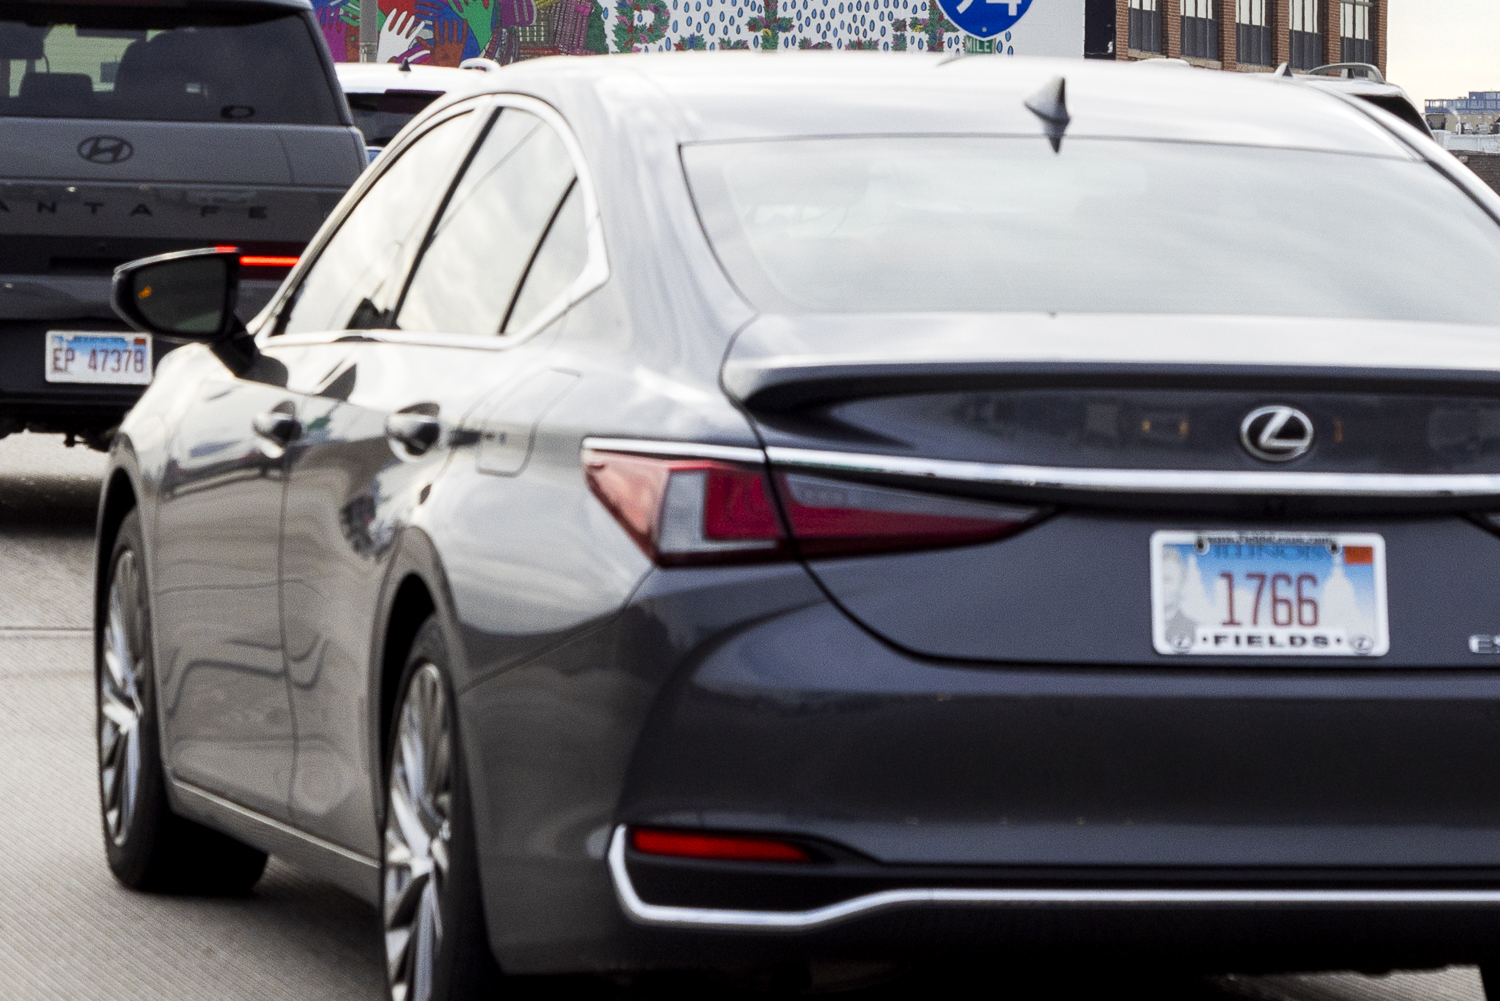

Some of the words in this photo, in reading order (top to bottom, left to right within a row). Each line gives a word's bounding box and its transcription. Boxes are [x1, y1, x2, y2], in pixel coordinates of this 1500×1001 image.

[53, 347, 75, 372] EP
[88, 348, 144, 373] 47378
[1220, 572, 1319, 627] 1766
[1214, 634, 1329, 647] FIELDS
